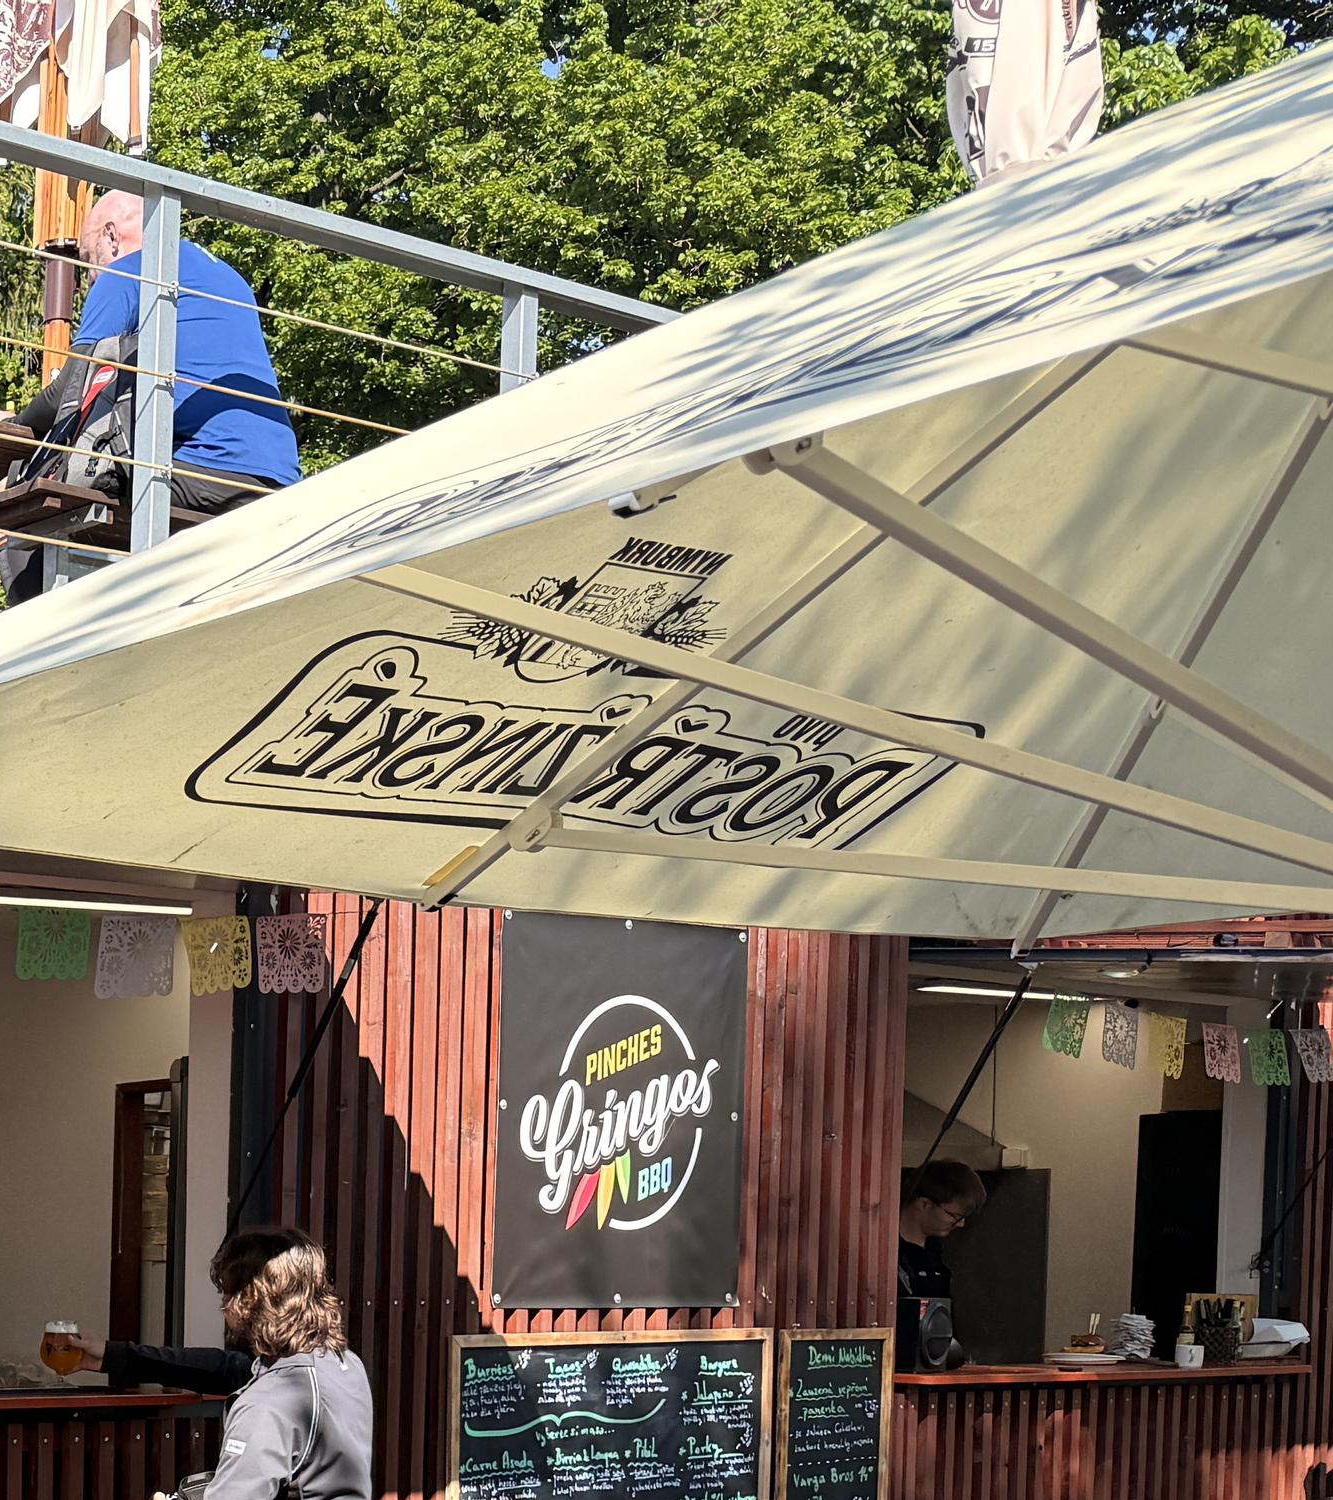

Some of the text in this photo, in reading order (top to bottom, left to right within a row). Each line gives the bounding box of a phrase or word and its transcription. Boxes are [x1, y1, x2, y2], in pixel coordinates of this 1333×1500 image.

[585, 1024, 662, 1086] PINCHES
[520, 1059, 720, 1214] Gringos
[637, 1156, 673, 1202] BBQ
[465, 1458, 498, 1473] Carne
